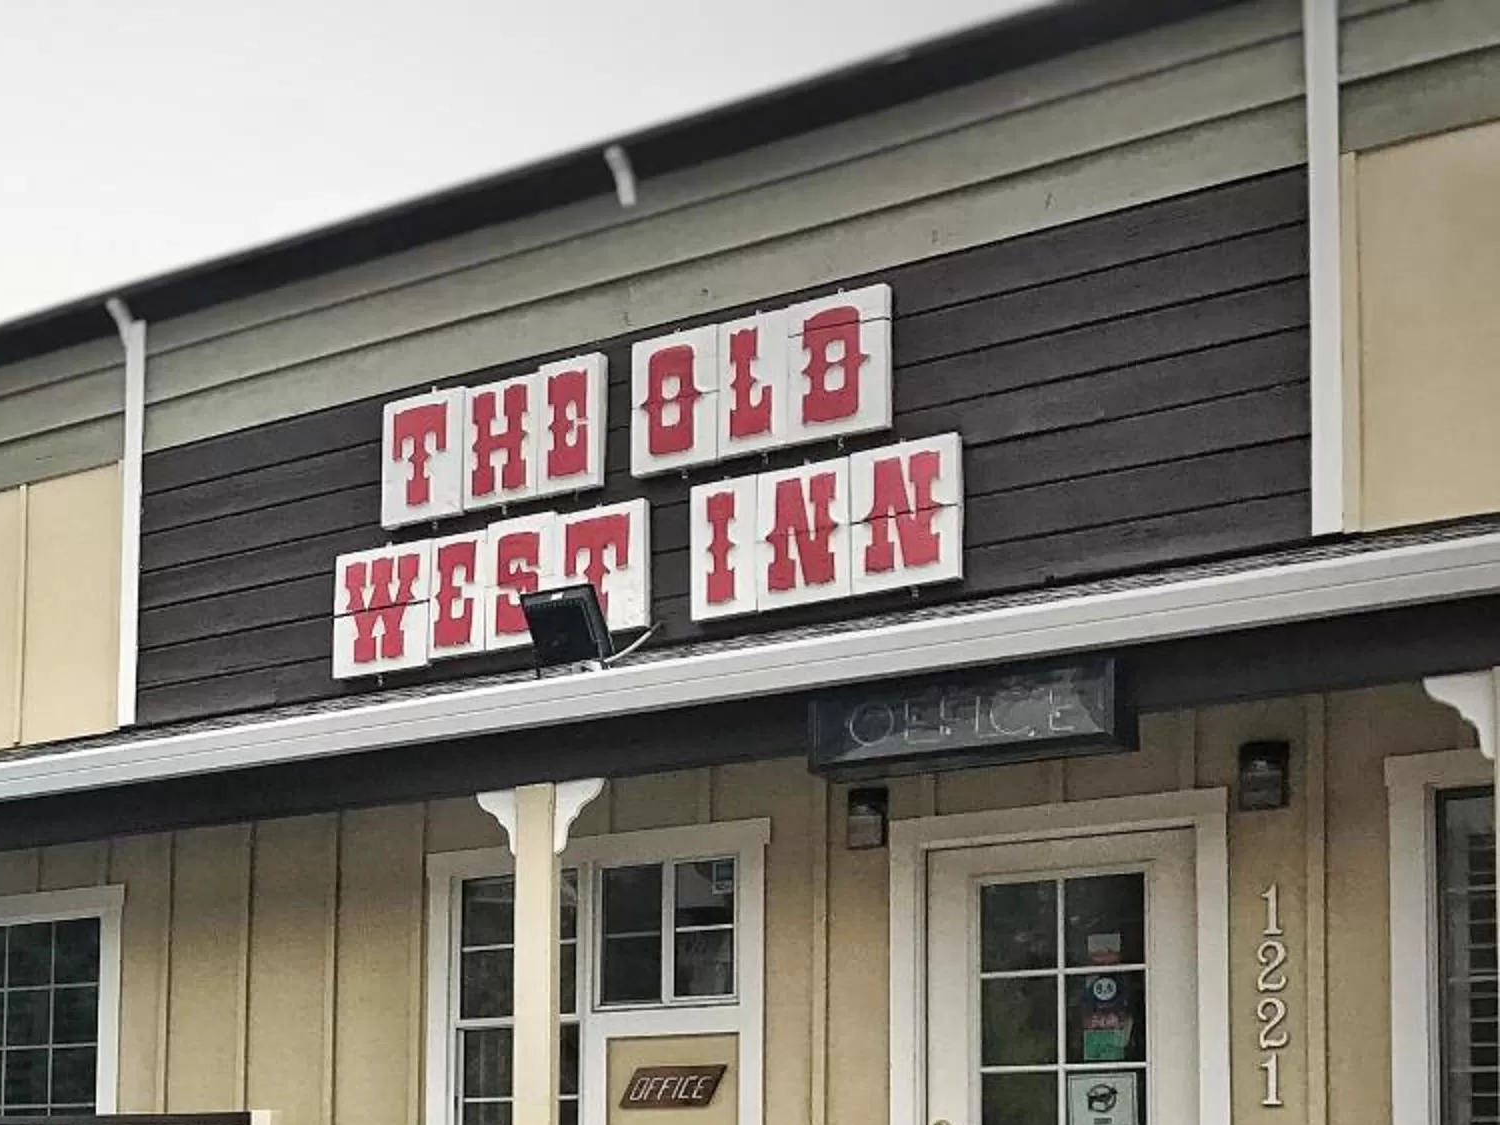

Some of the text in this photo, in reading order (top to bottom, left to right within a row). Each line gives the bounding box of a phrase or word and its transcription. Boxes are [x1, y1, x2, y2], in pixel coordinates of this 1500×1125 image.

[392, 306, 869, 506] THE OLD
[345, 451, 942, 664] WEST INN
[629, 1075, 712, 1101] OFFICE
[1257, 883, 1288, 1106] 1221
